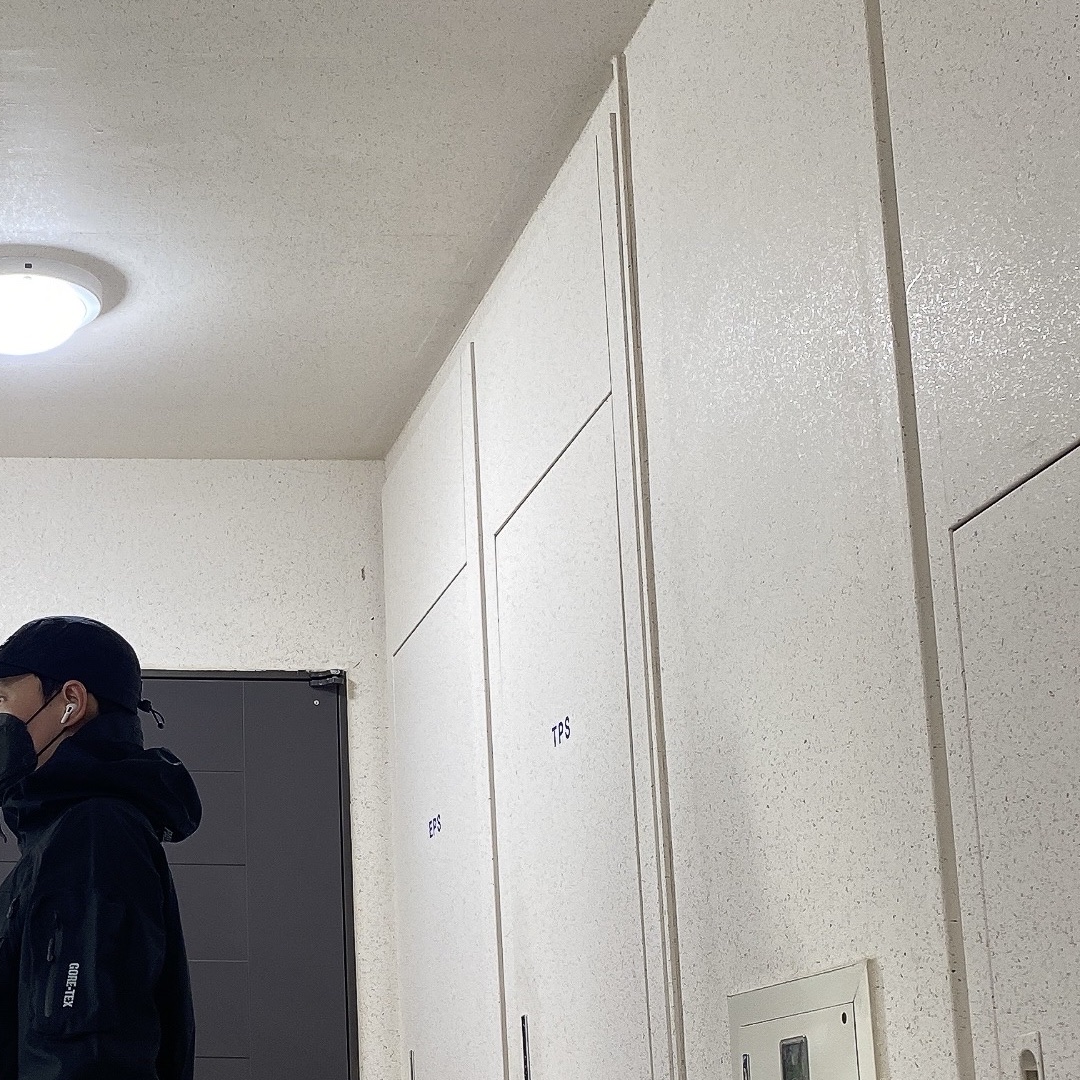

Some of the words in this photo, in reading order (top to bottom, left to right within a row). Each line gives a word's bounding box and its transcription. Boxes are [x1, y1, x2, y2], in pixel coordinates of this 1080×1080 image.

[551, 715, 571, 748] TPS
[428, 813, 442, 839] EPS
[62, 962, 80, 1008] GORE-TEX
